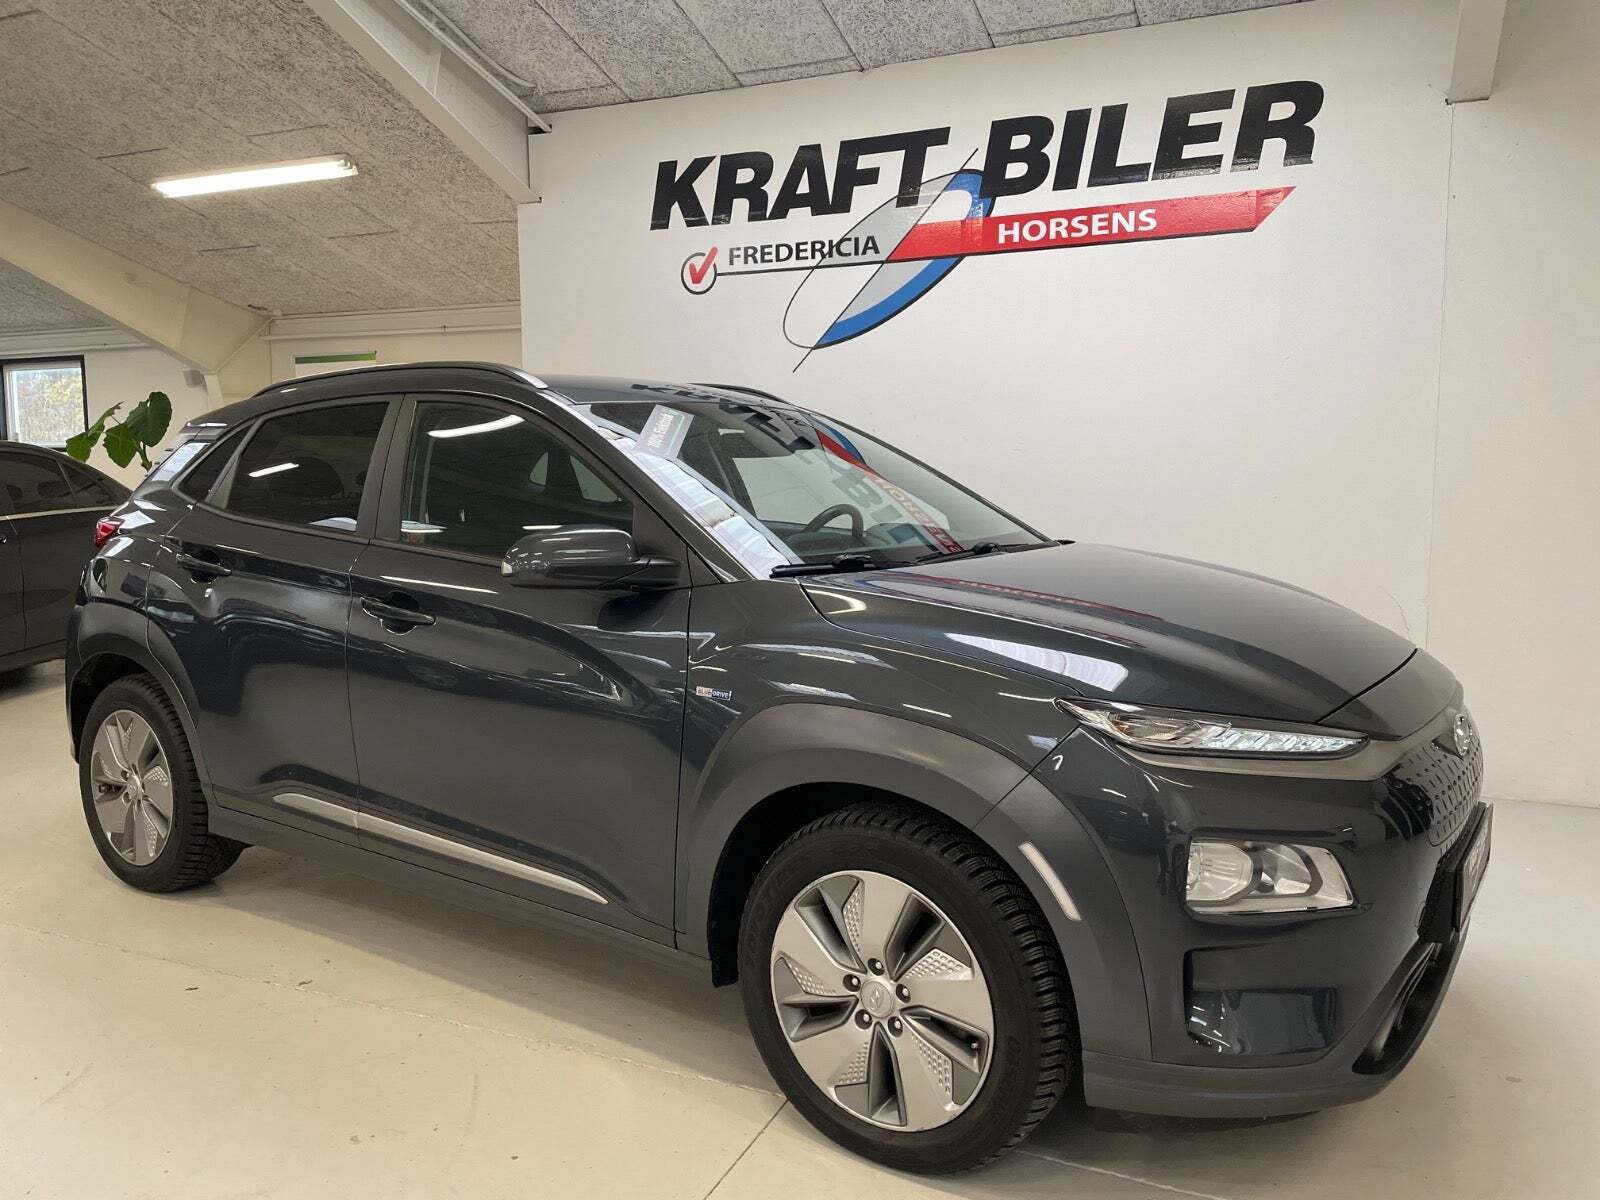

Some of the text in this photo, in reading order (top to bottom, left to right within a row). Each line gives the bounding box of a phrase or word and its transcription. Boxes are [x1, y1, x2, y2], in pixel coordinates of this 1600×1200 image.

[650, 80, 1325, 231] KRAFT BILER
[998, 208, 1158, 244] HORSENS
[728, 235, 881, 266] FREDERICIA
